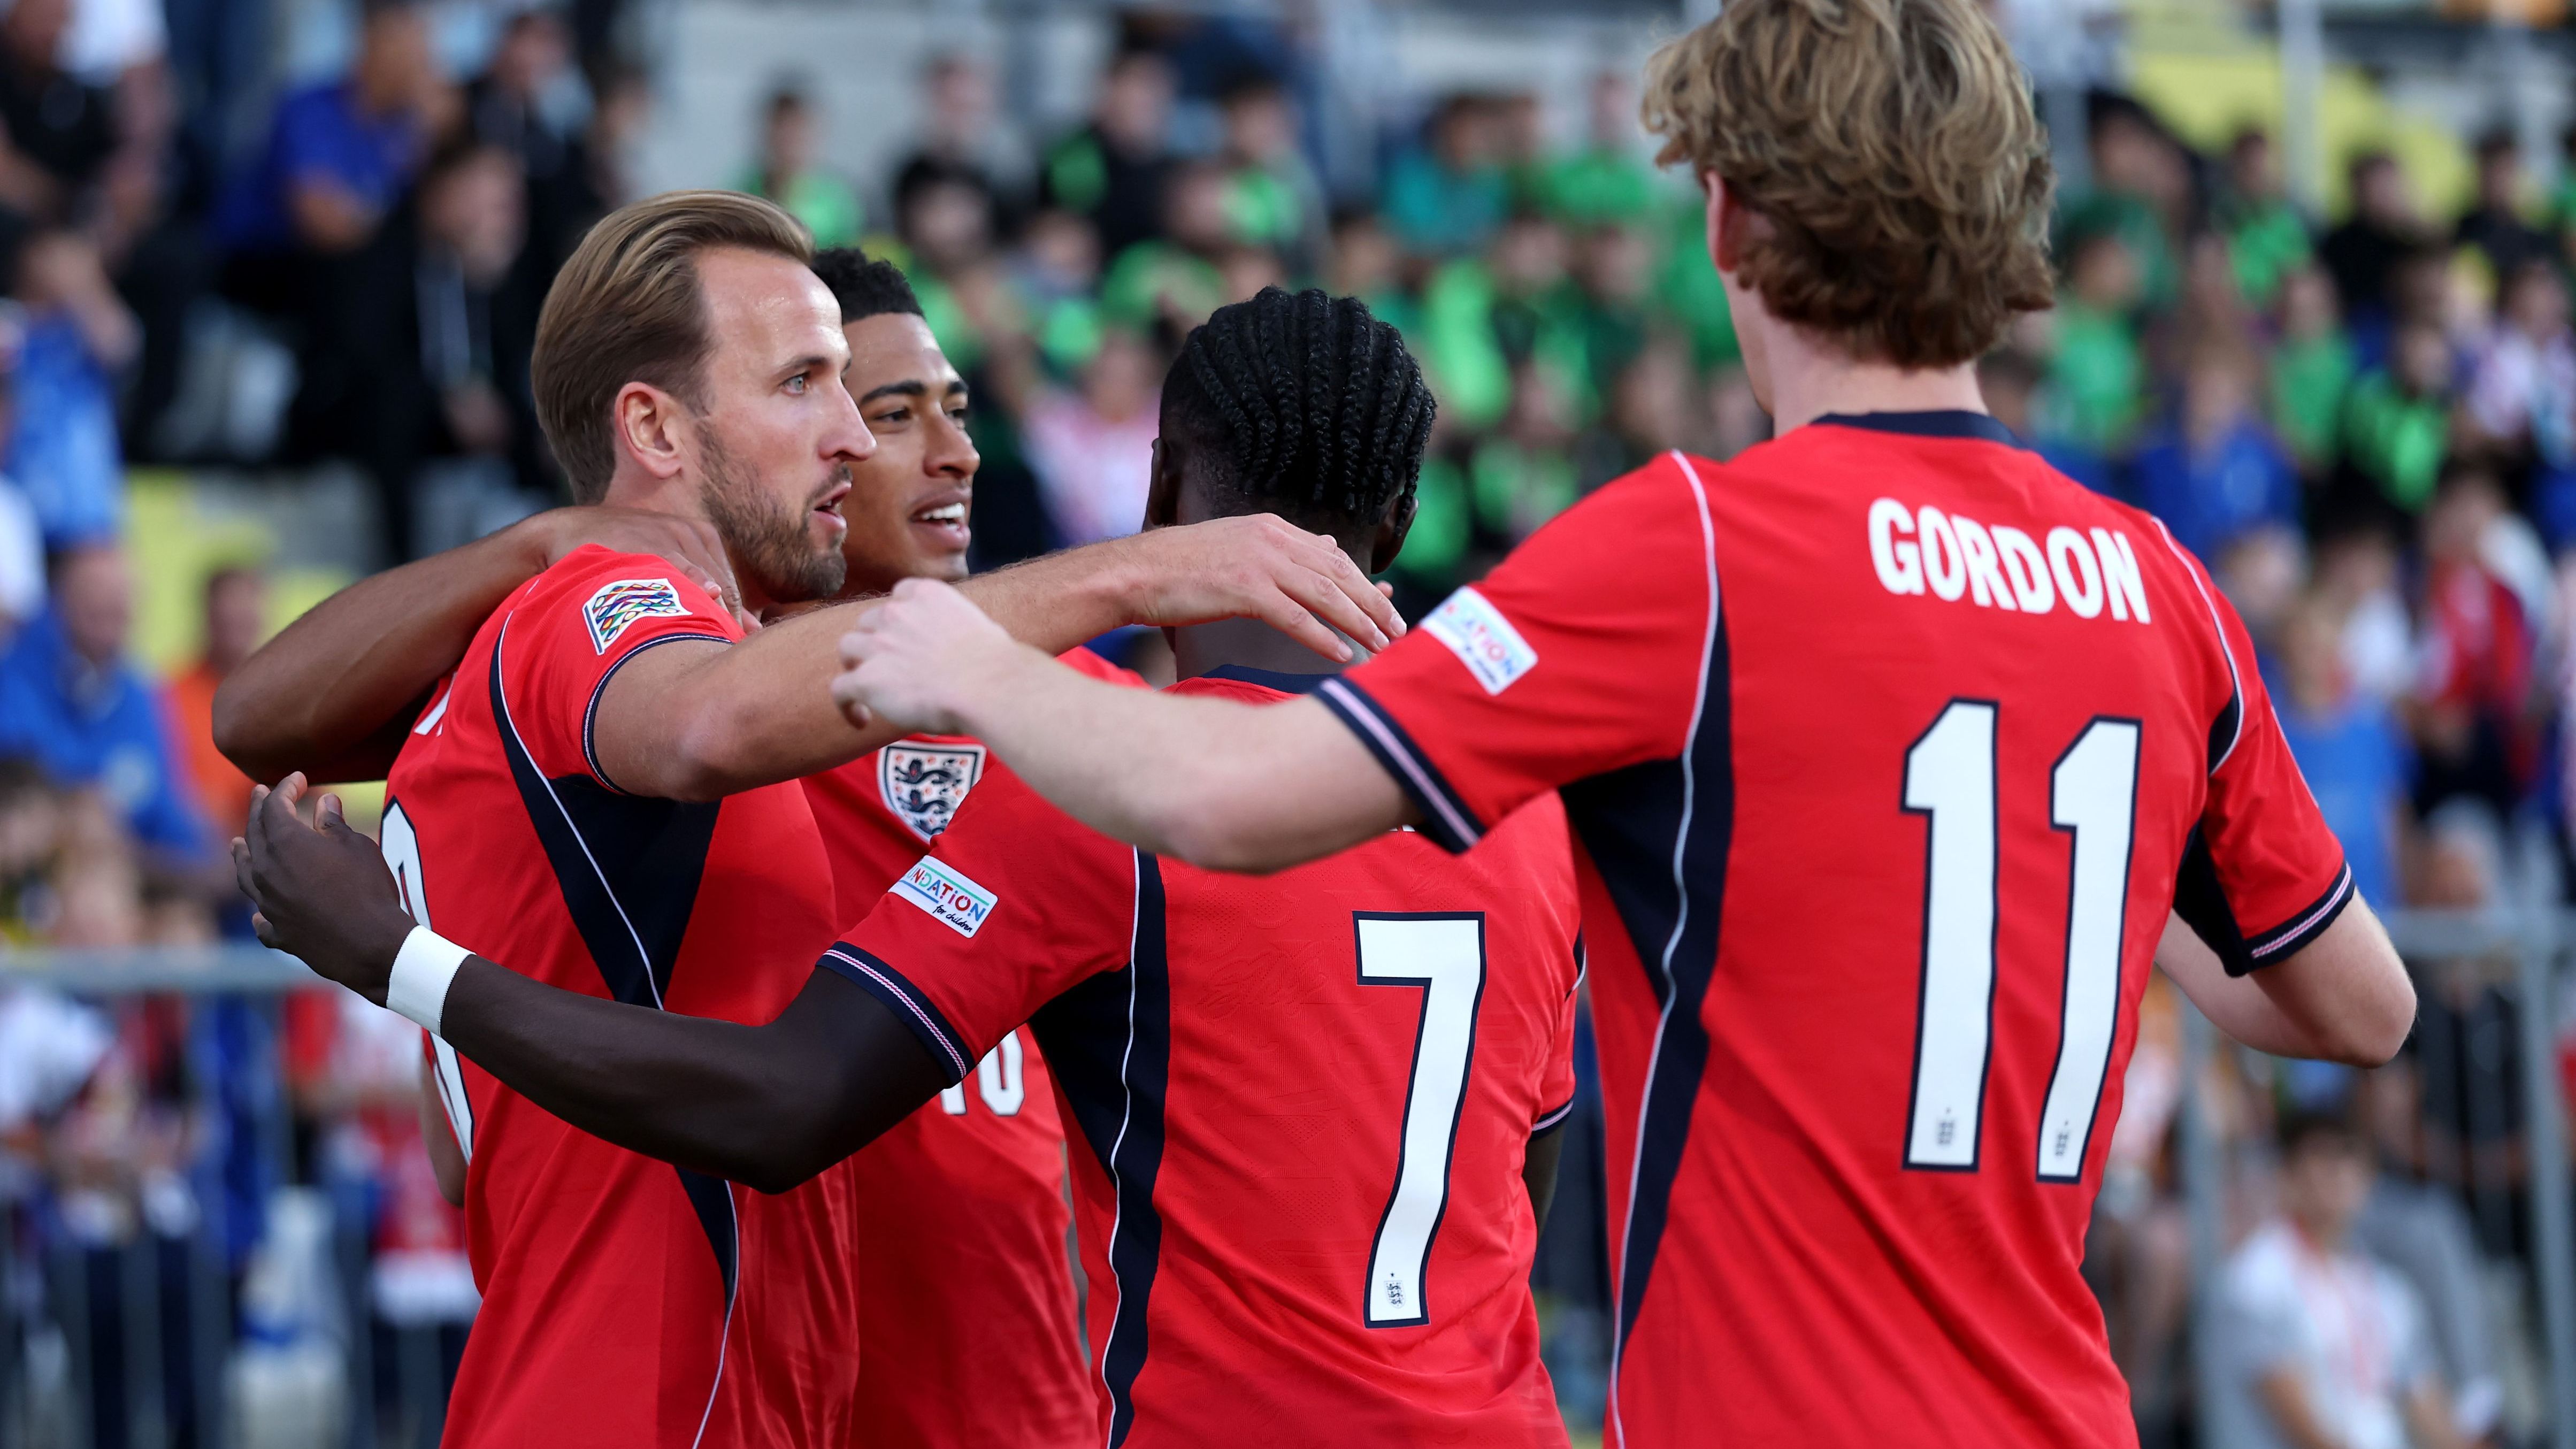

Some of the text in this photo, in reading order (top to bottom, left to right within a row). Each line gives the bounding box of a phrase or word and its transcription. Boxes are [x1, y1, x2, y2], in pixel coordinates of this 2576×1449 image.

[1867, 496, 2152, 624] GORDON
[932, 904, 972, 932] for children
[1900, 696, 2143, 1183] 11
[1352, 910, 1486, 1328] 7
